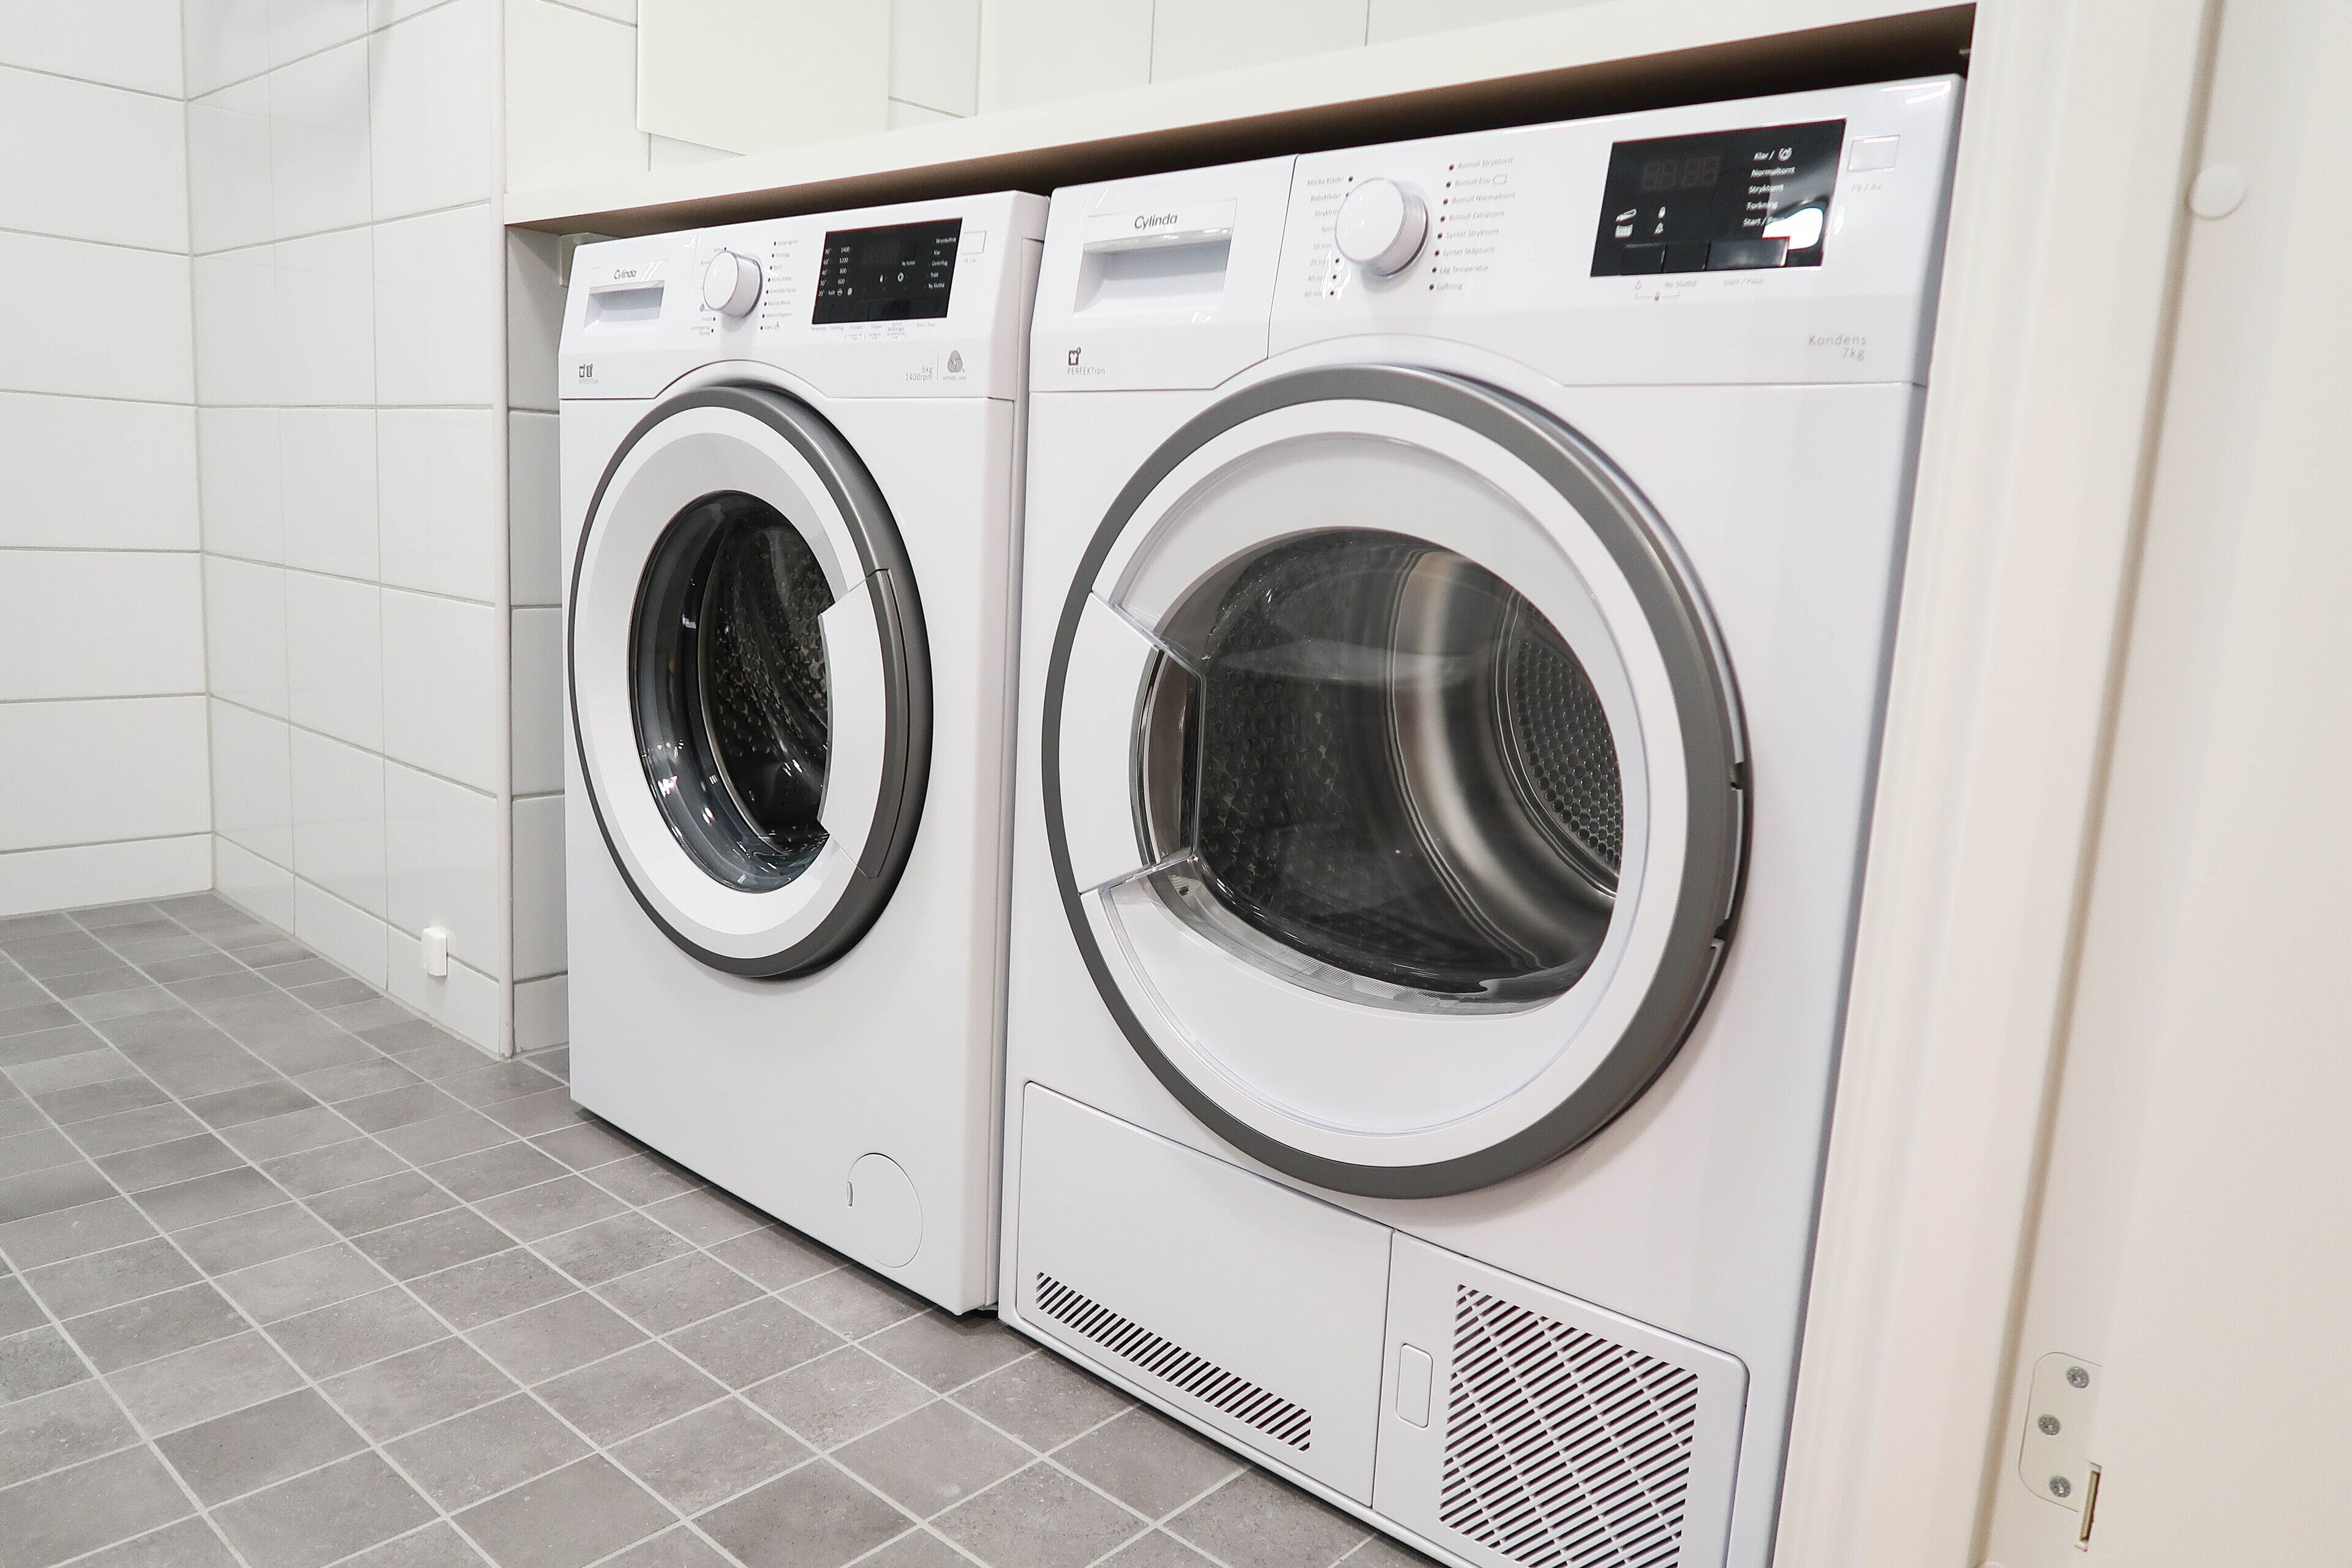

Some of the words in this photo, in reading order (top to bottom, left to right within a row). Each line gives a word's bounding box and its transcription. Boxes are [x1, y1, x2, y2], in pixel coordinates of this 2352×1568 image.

[1134, 213, 1178, 230] Cylinda
[1842, 347, 1866, 361] 7kg
[922, 366, 933, 374] 6kg
[1067, 367, 1106, 375] PERFEKTion
[906, 373, 933, 382] 1400rpm
